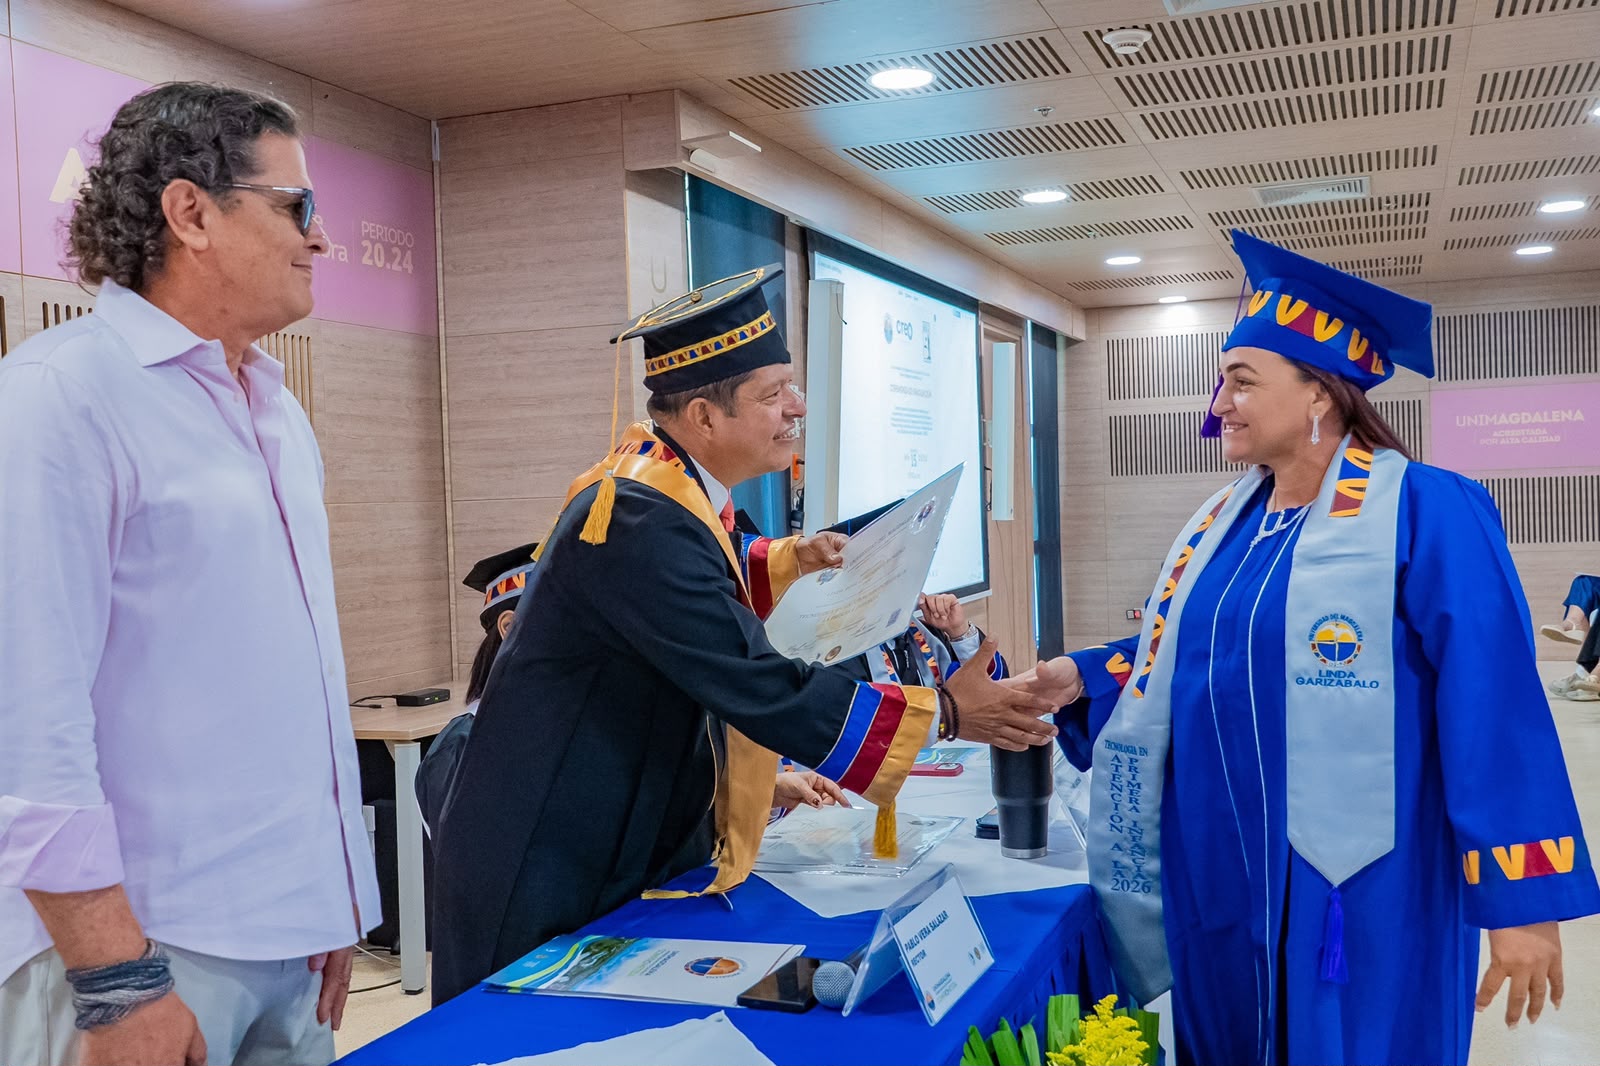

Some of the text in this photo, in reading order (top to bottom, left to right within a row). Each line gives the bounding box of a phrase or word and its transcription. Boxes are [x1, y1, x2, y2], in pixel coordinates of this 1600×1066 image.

[361, 221, 414, 248] PERIODO
[361, 240, 414, 274] 20.24
[1456, 408, 1584, 427] UNIMAGDALENA
[1492, 428, 1548, 437] ACREDITADA
[1480, 438, 1498, 446] POR
[1521, 435, 1561, 444] CALIDAD
[1318, 669, 1356, 679] LINDA
[1295, 676, 1380, 689] GARIZABALO
[1139, 745, 1149, 757] EN
[1111, 842, 1123, 852] A
[1111, 878, 1151, 894] 2026
[904, 910, 949, 952] PABLO VERA SALAZAR
